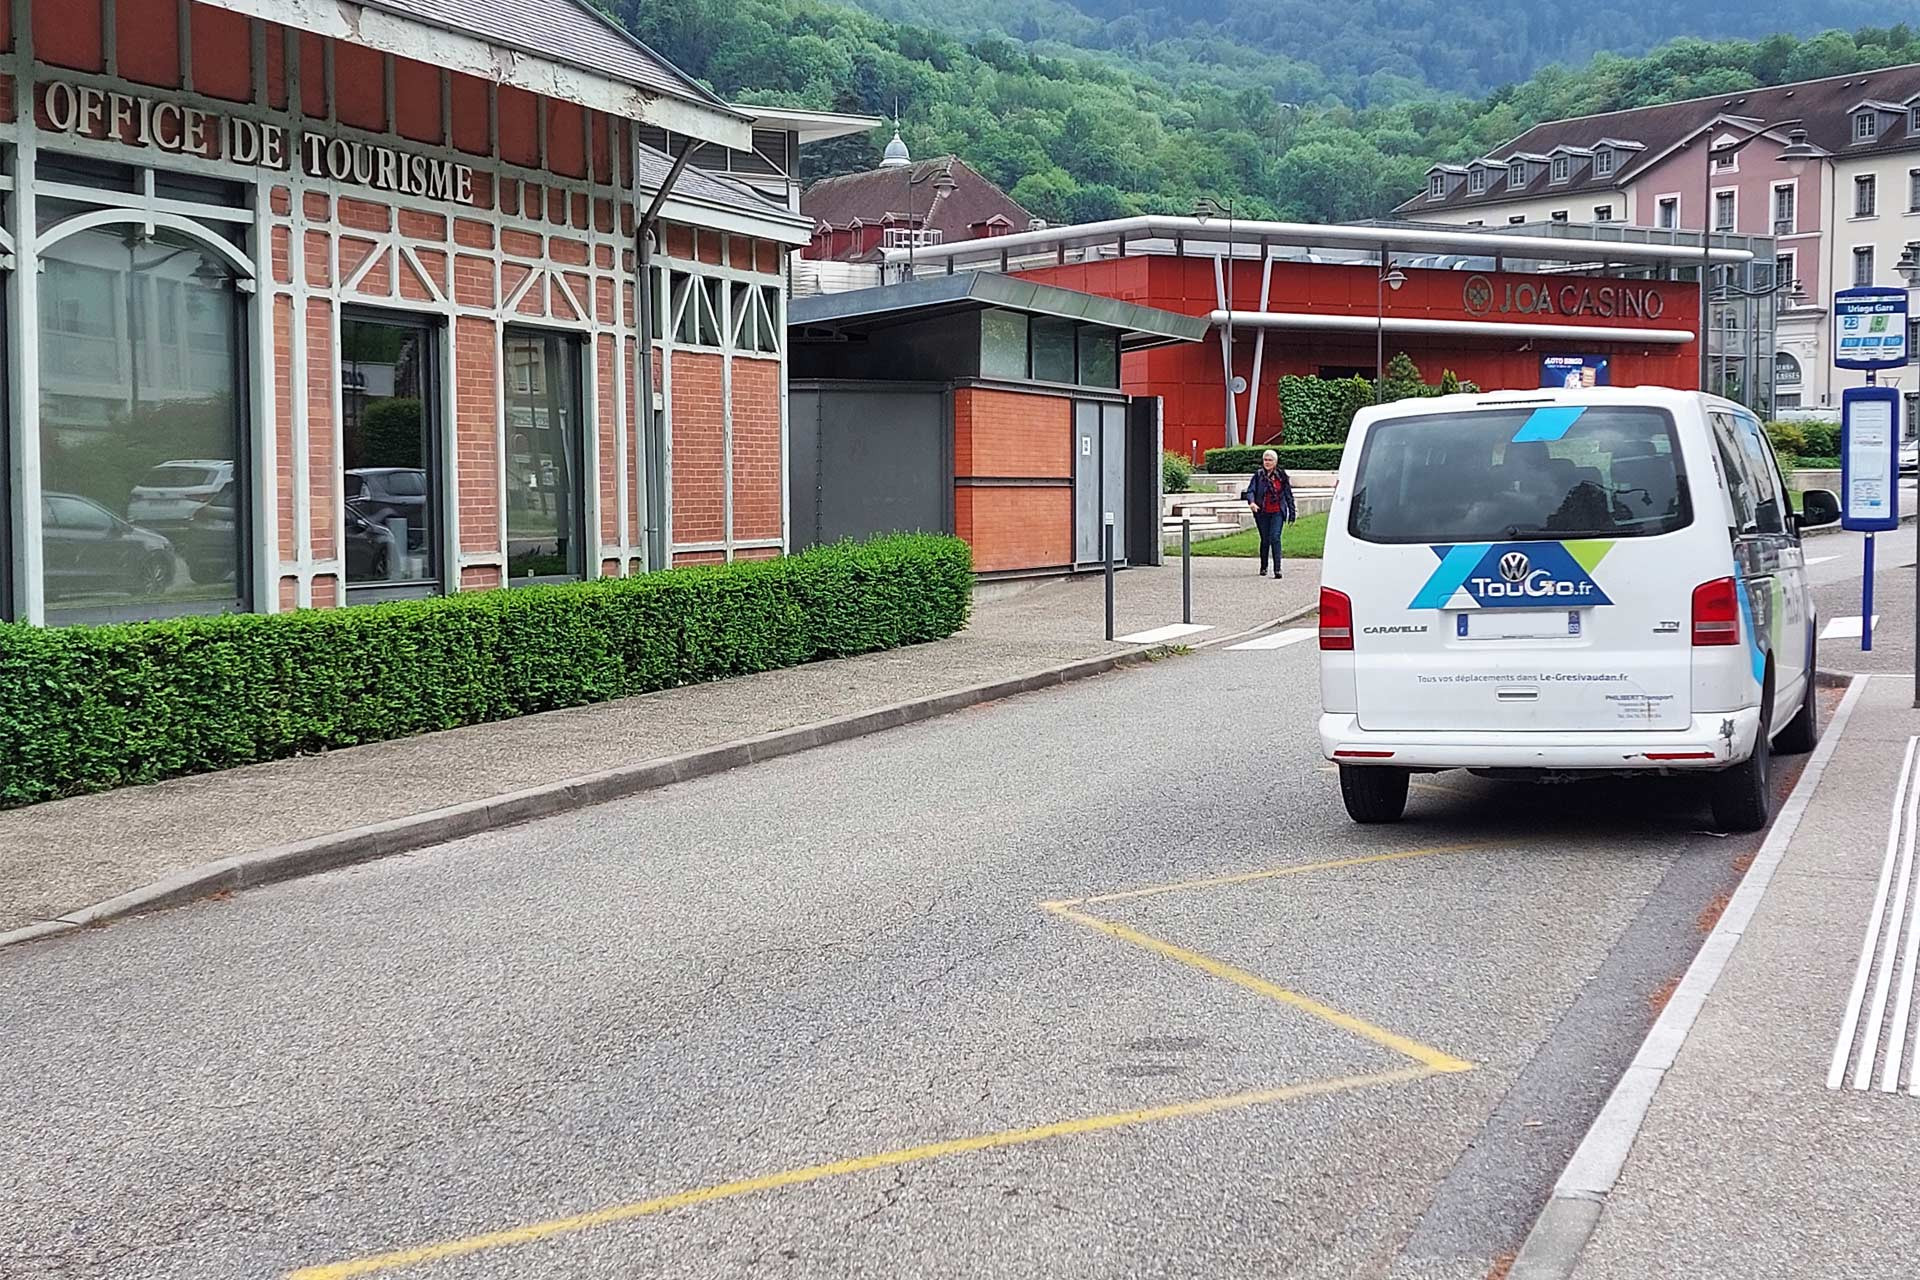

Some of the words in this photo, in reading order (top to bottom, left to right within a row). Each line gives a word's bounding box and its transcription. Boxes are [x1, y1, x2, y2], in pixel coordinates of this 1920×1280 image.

[45, 80, 208, 155] OFFICE
[231, 117, 283, 169] DE
[303, 131, 474, 204] TOURISME
[1500, 283, 1555, 314] JOA
[1559, 285, 1664, 319] CASINO
[1847, 304, 1874, 313] Uriage
[1845, 317, 1858, 328] 23
[1363, 625, 1428, 634] CARAVELLE
[1418, 675, 1437, 683] Tous
[1455, 674, 1515, 684] déplacements
[1517, 673, 1538, 681] dans
[1540, 673, 1628, 682] Le-Gresivaudan.fr
[1641, 694, 1674, 702] Transport
